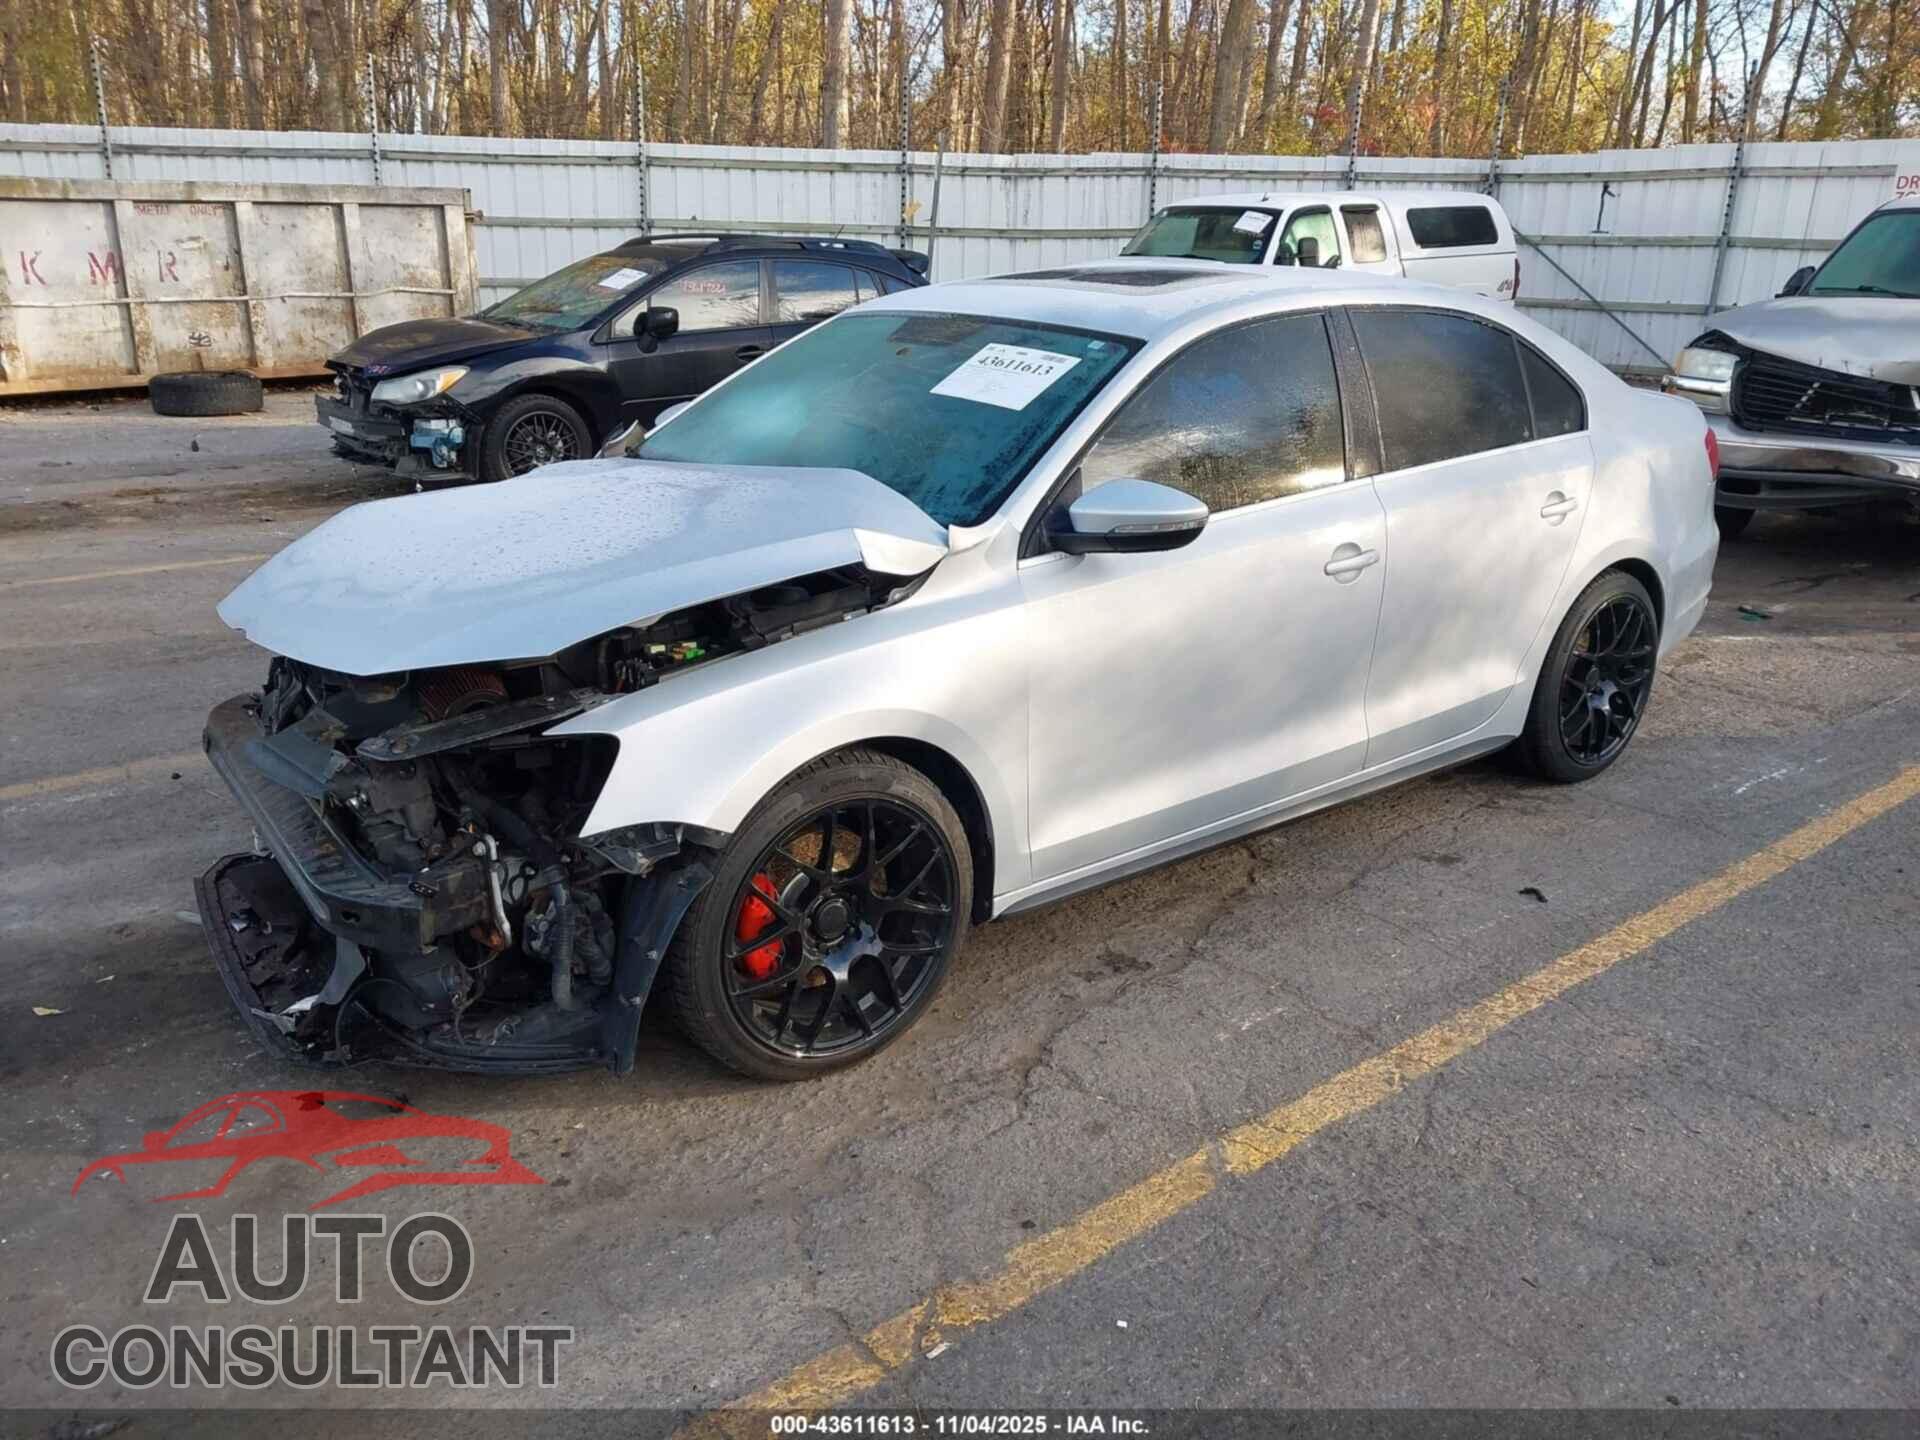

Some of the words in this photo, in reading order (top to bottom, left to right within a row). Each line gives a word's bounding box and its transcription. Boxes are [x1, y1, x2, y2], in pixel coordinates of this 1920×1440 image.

[20, 250, 48, 286] K
[88, 251, 120, 286] M
[157, 250, 179, 283] R
